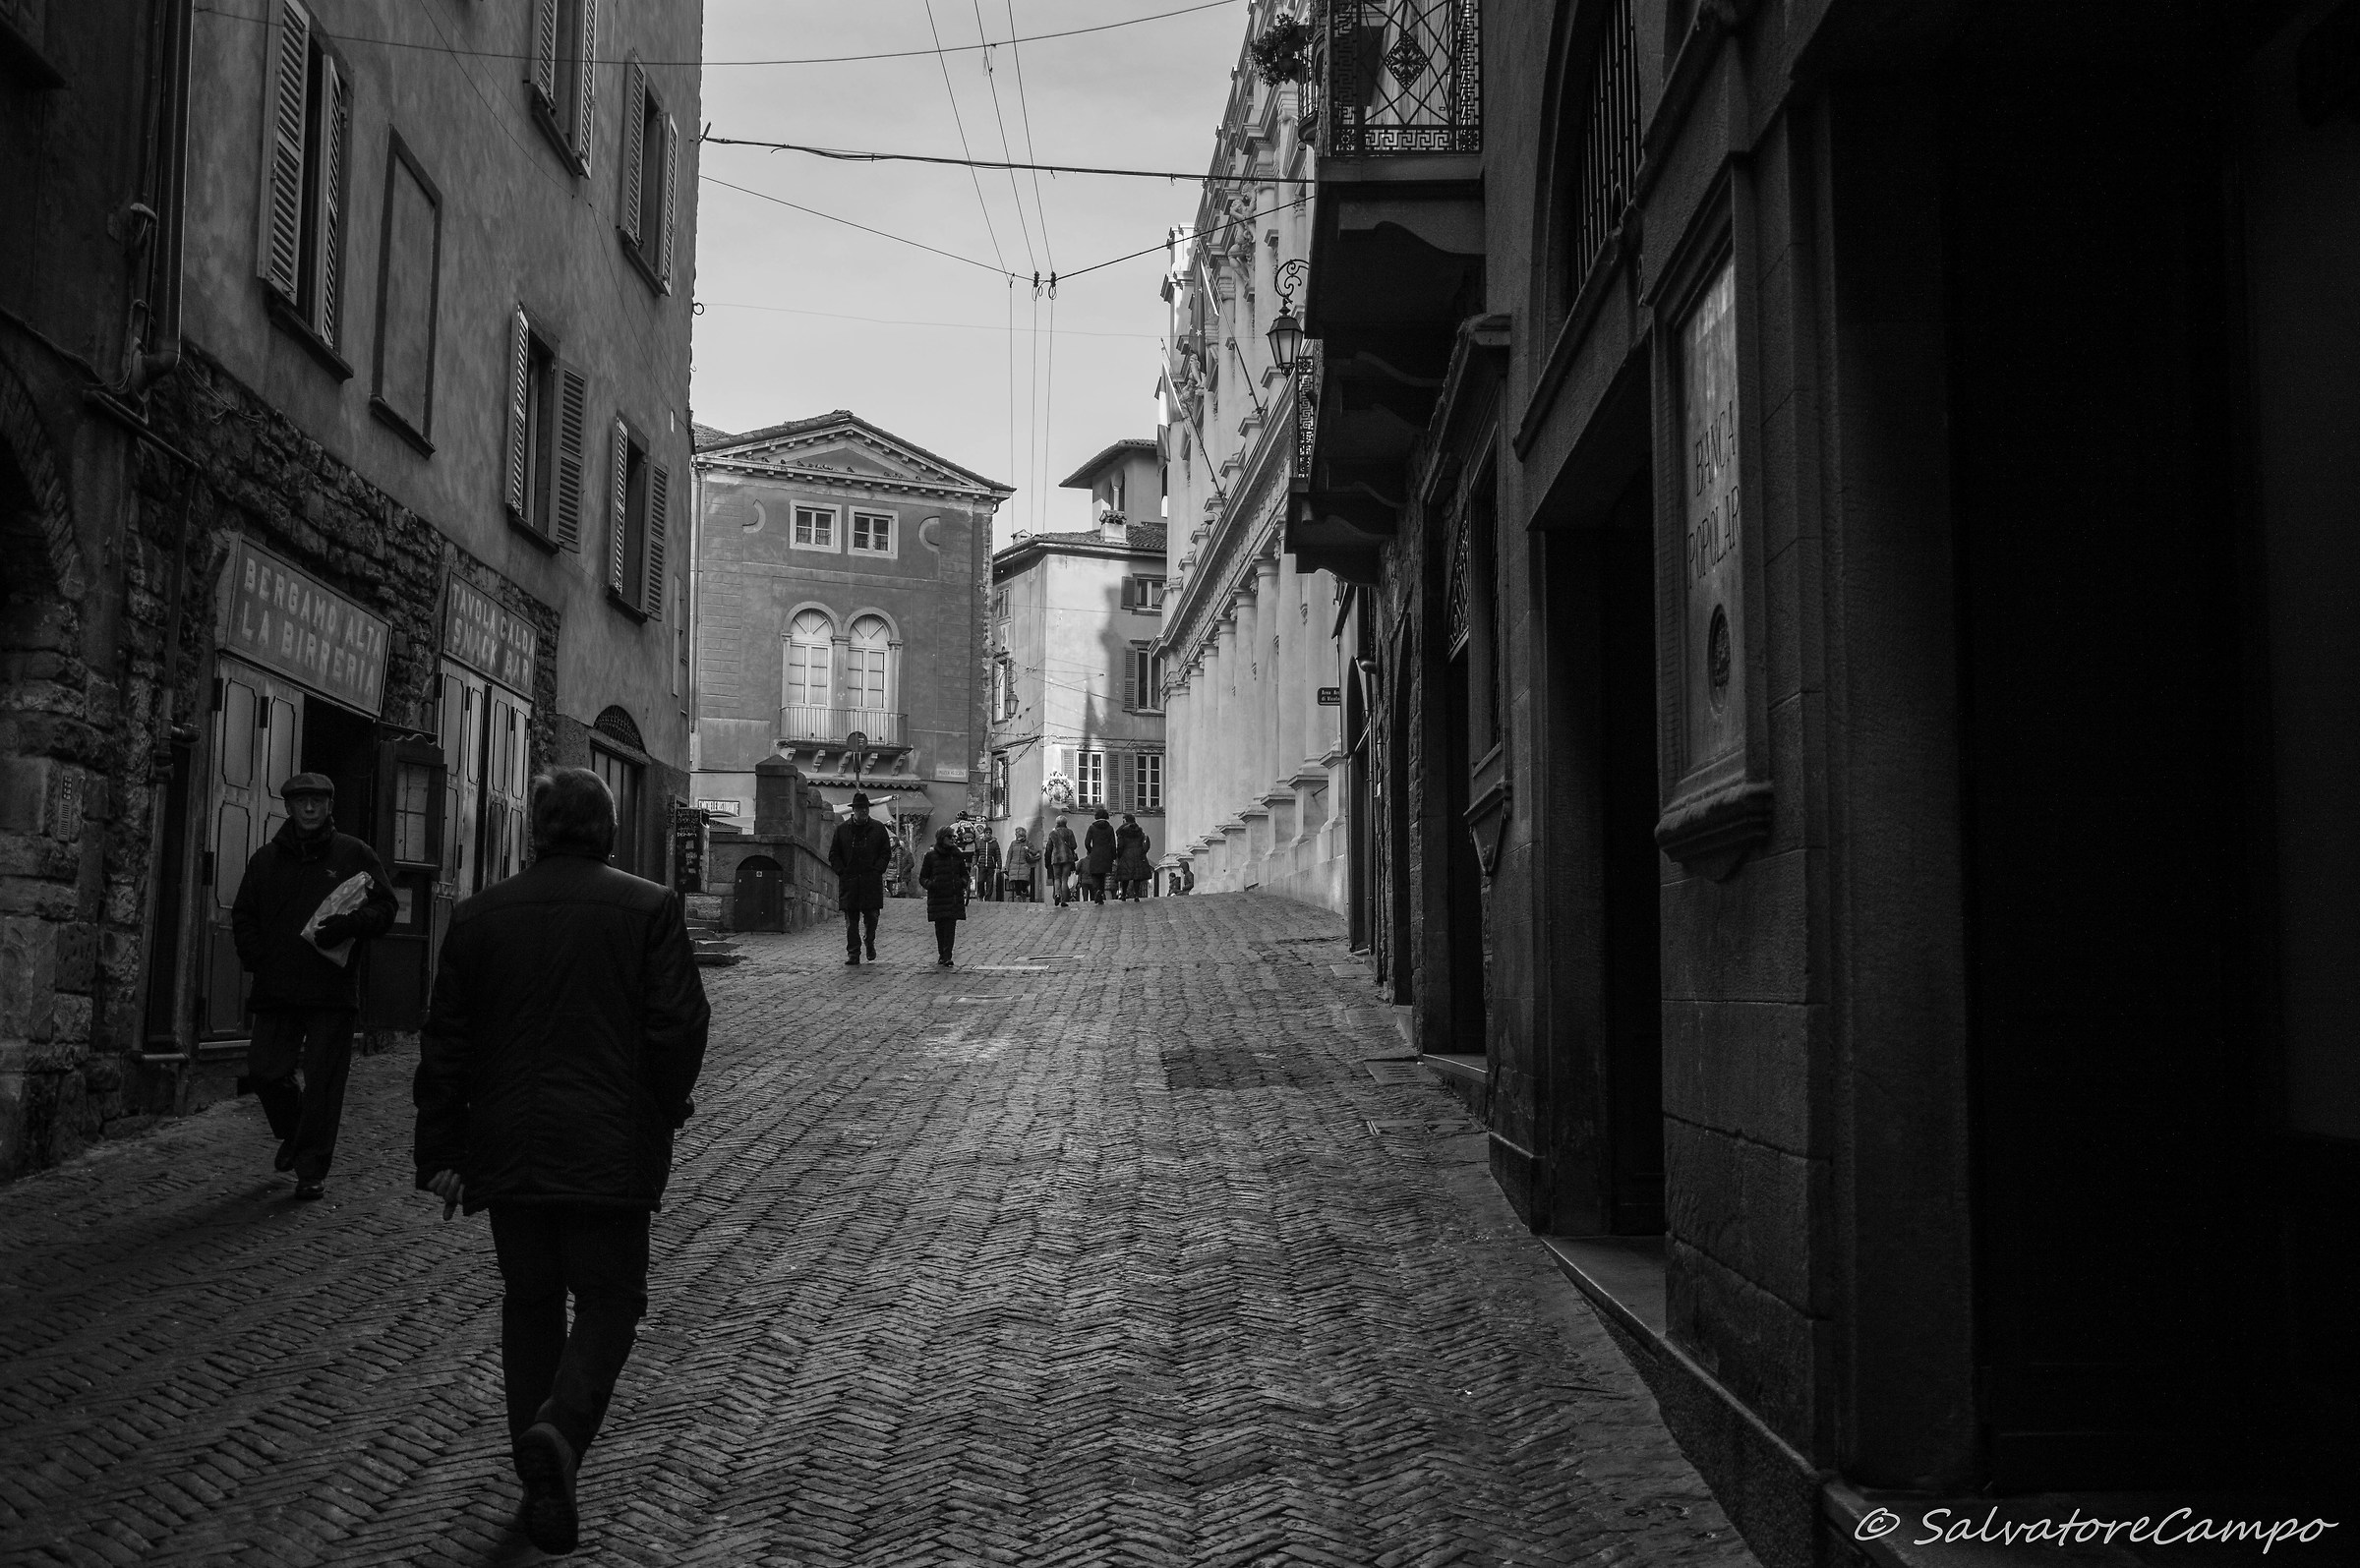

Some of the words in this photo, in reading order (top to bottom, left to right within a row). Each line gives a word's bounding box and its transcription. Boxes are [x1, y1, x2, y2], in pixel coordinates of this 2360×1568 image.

[1695, 399, 1737, 496] BANCA
[1687, 485, 1740, 590] POPOLAR
[241, 600, 270, 647] LA
[281, 620, 376, 696] BIRRERIA
[245, 556, 337, 635] BERGAMO
[345, 614, 382, 661] ALTA
[452, 583, 497, 635] TAVOLA
[500, 615, 535, 659] CALDA
[453, 616, 499, 668] SNACK
[502, 649, 529, 686] BAR
